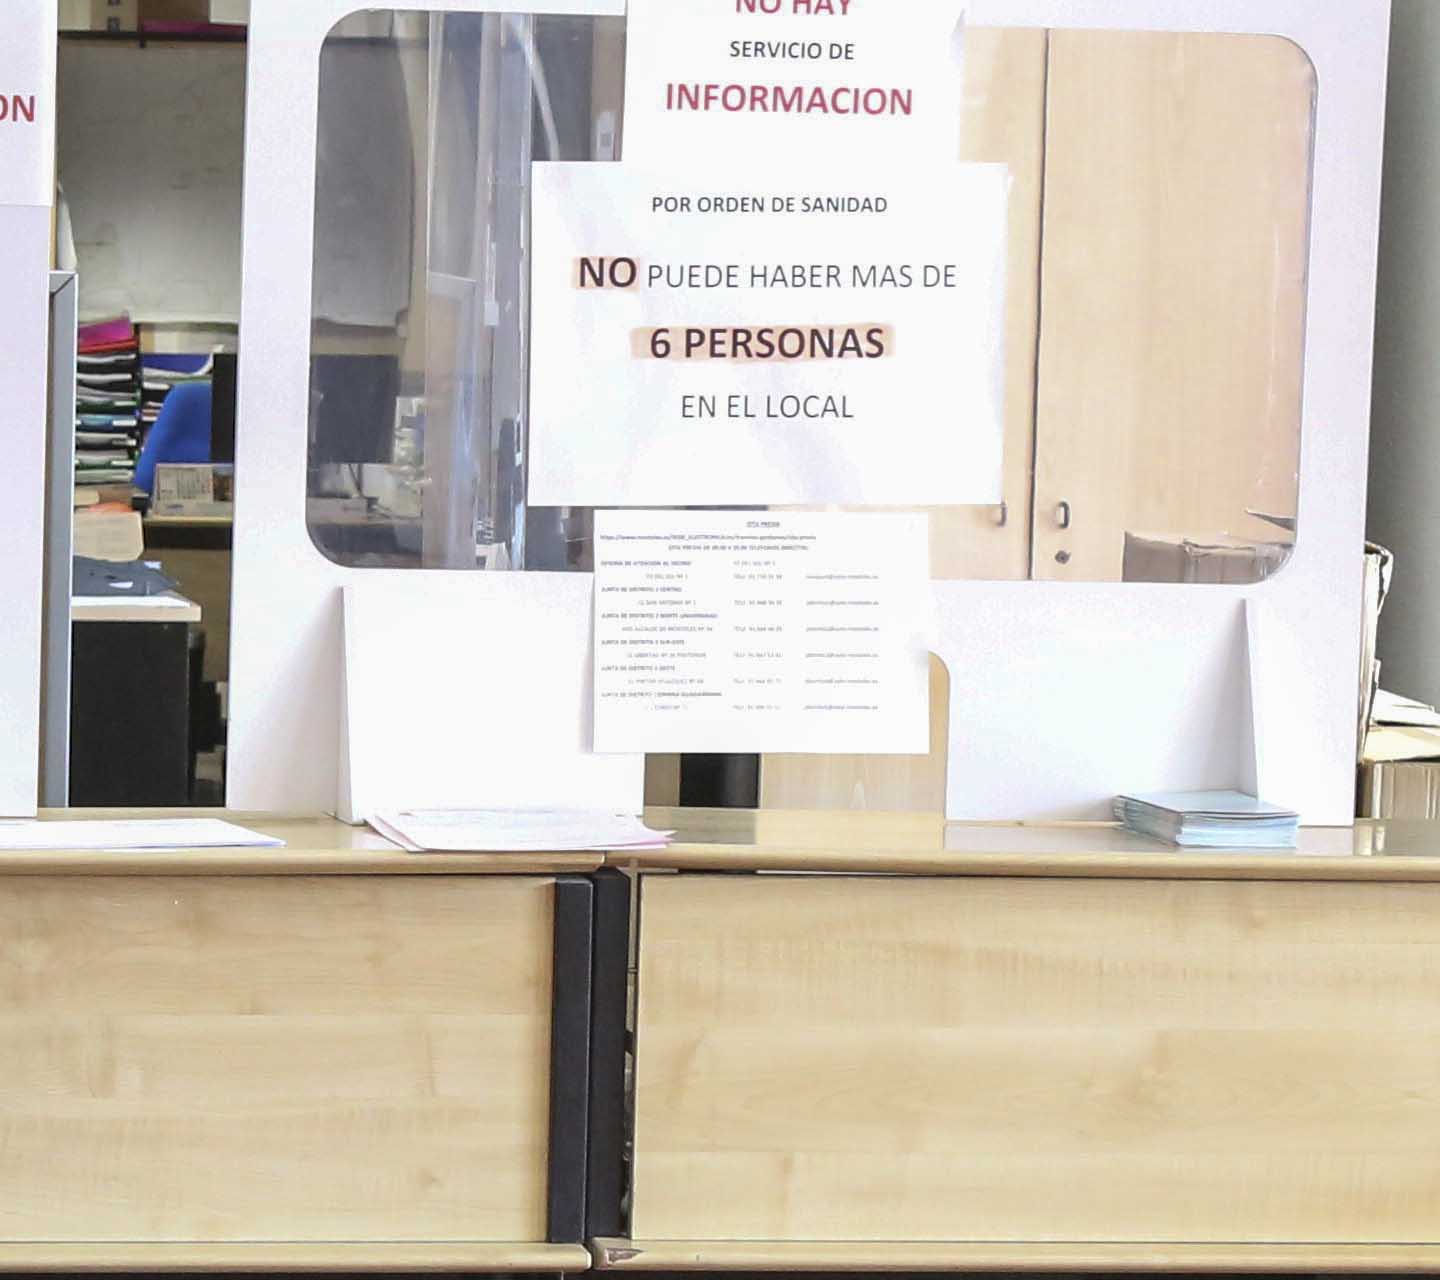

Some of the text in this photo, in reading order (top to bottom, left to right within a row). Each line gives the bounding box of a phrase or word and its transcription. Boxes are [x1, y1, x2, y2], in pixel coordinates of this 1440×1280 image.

[729, 39, 854, 60] SERVICIO DE
[665, 82, 912, 115] INFORMACION
[651, 195, 887, 213] POR ORDEN DE SANIDAD
[579, 256, 956, 288] NO PUEDE HABER MAS DE
[650, 327, 884, 359] 6 PERSONAS
[681, 394, 854, 418] EN EL LOCAL
